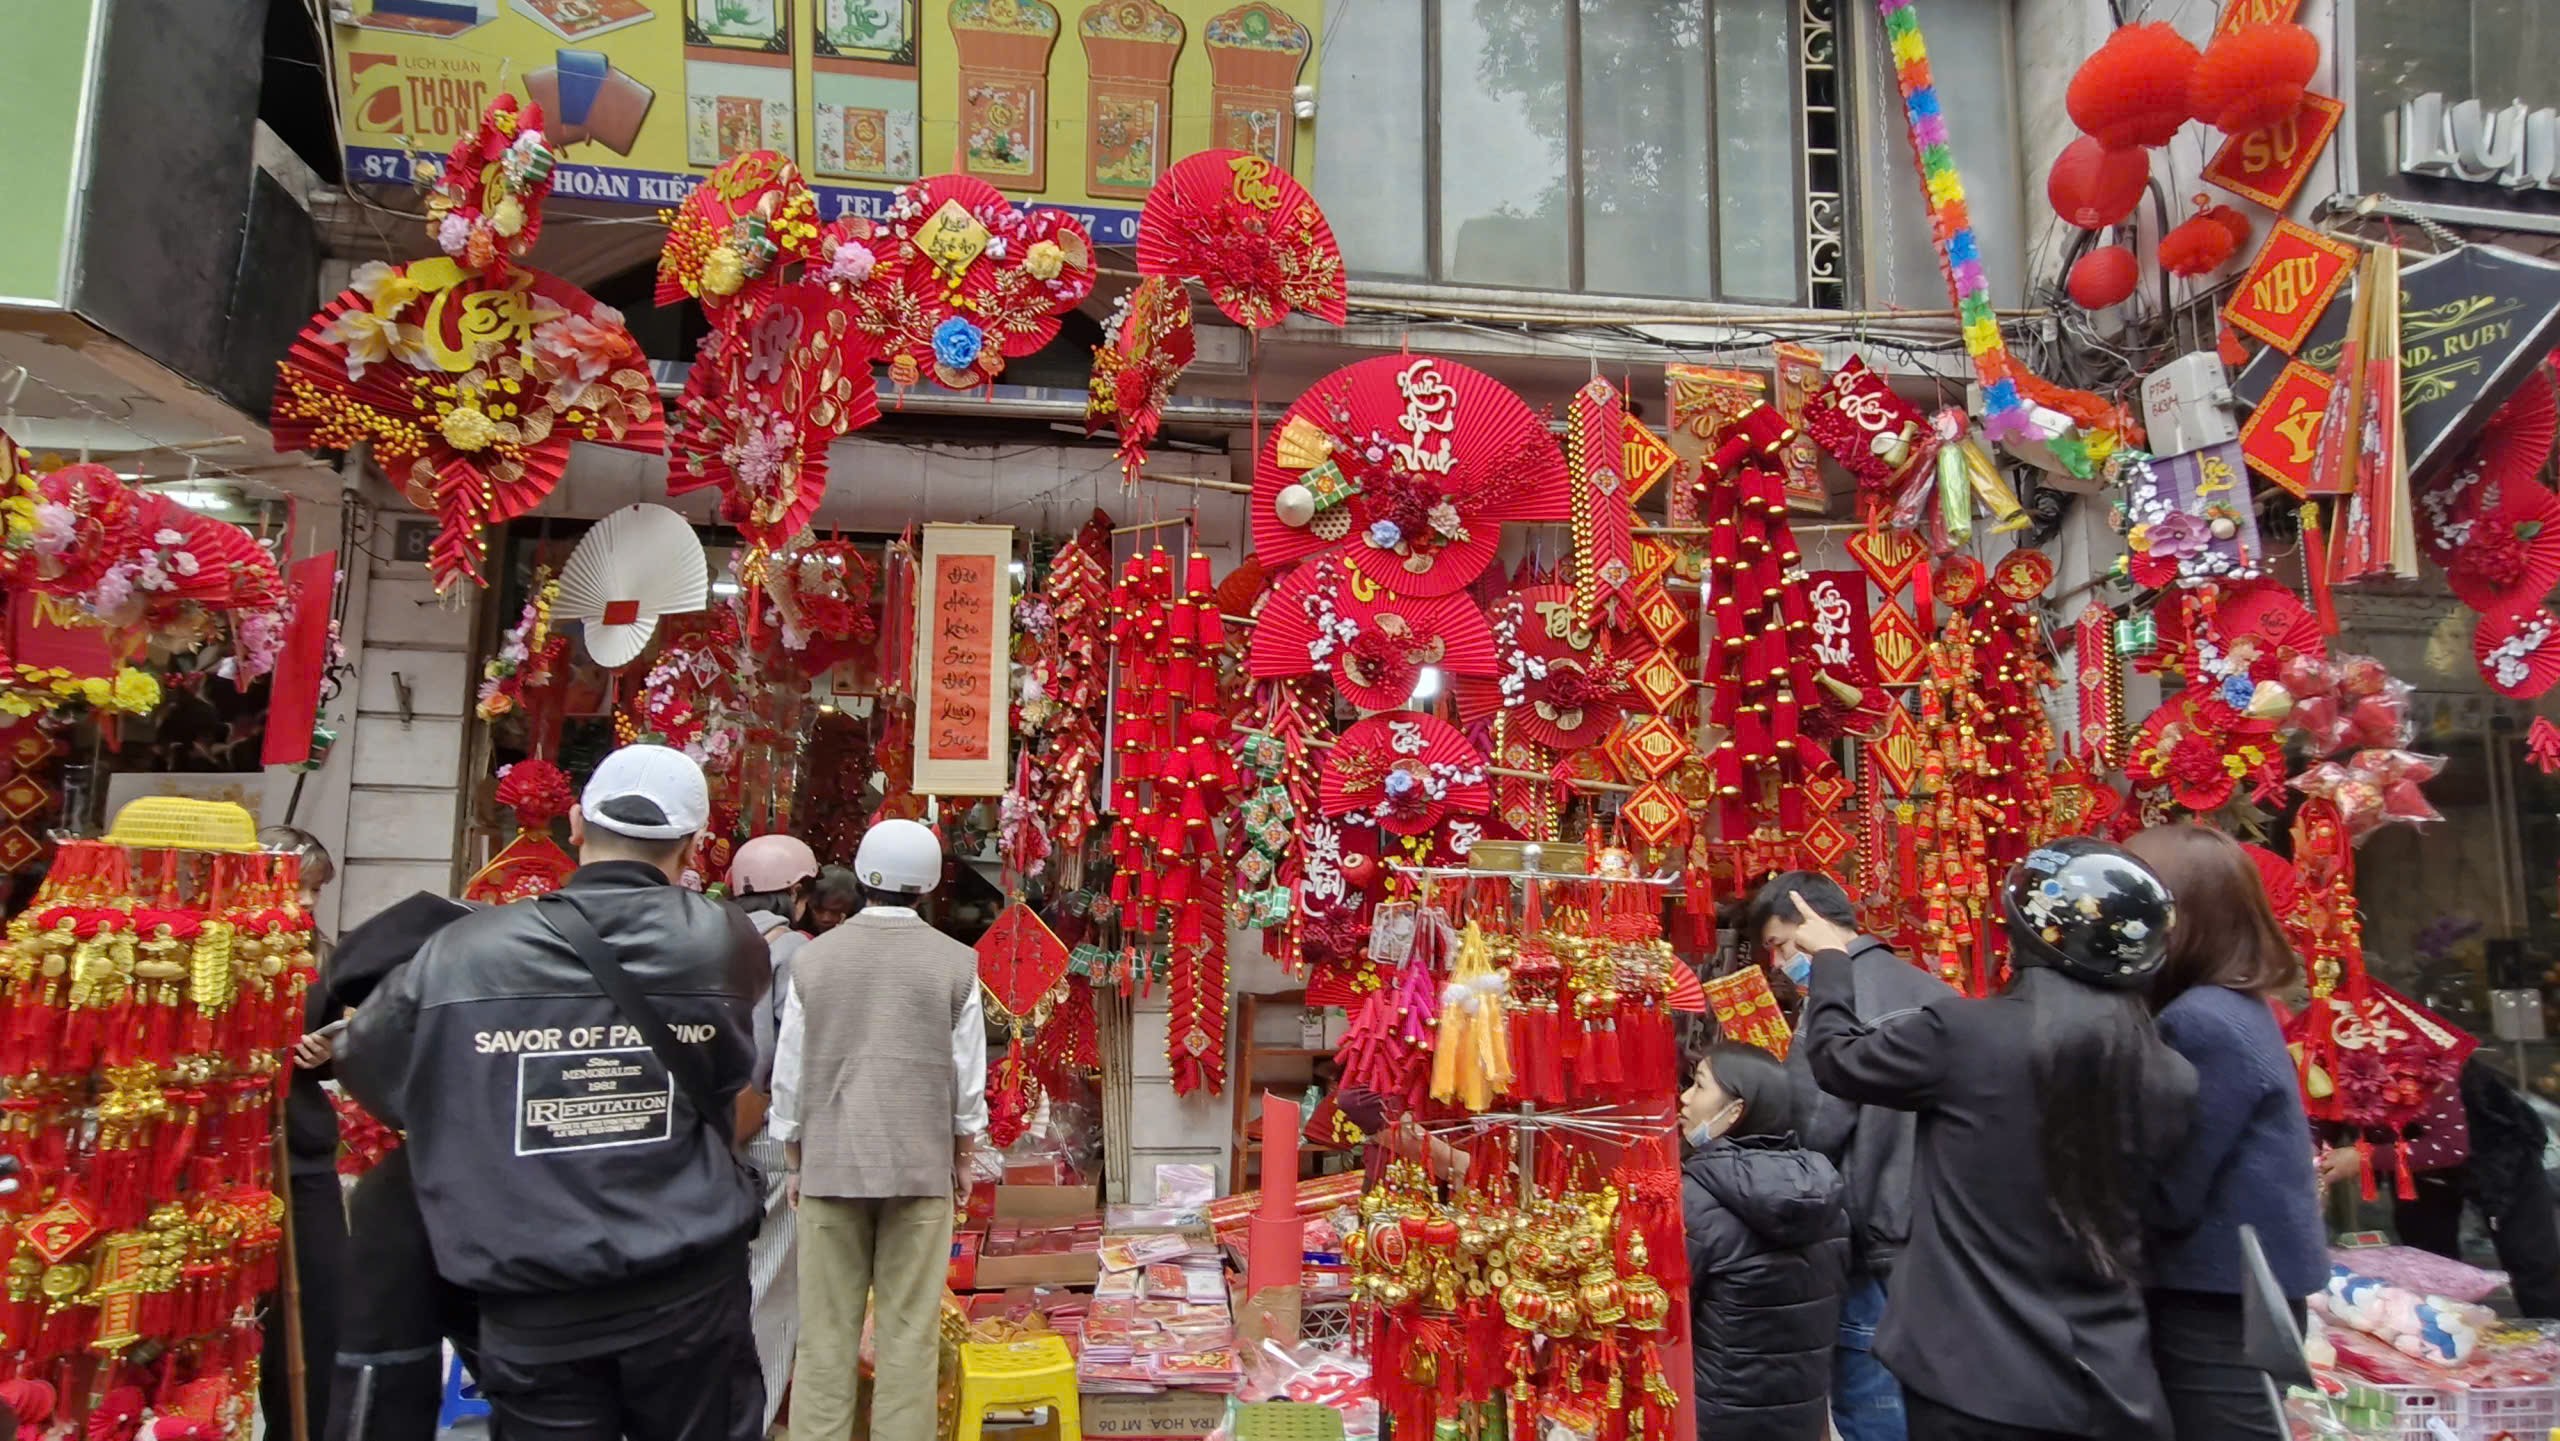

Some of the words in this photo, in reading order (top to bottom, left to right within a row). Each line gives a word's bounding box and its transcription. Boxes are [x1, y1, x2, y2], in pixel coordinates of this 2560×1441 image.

[364, 154, 399, 179] 87
[552, 166, 630, 198] HOÀN
[2252, 251, 2320, 315] NHƯ
[2443, 318, 2513, 357] RUBY
[1649, 603, 1675, 630] AN
[474, 1027, 562, 1054] SAVOR
[568, 1026, 606, 1049] OF
[1098, 1419, 1117, 1432] 06
[1120, 1418, 1142, 1431] MT
